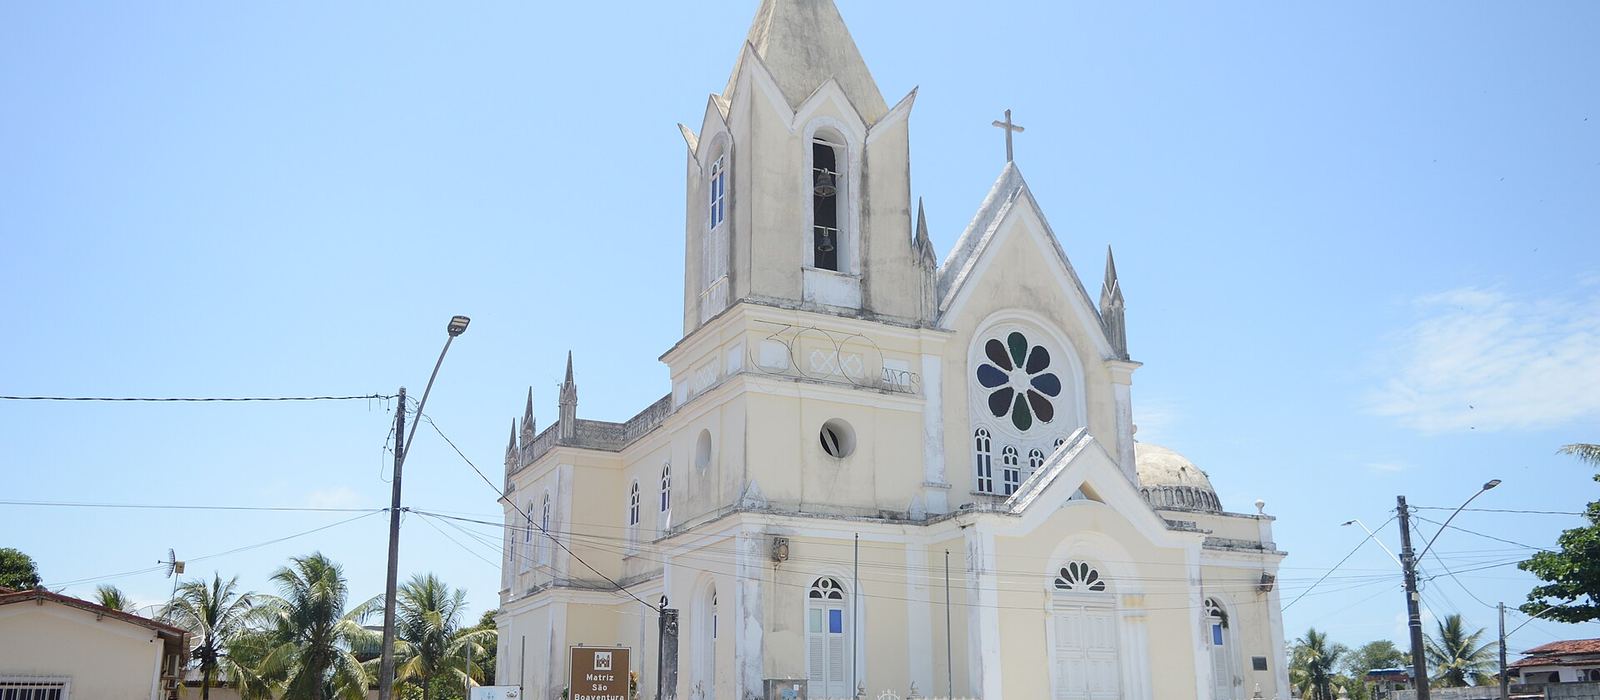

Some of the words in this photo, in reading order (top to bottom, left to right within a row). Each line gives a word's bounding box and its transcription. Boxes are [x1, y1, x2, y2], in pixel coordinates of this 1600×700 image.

[749, 319, 884, 388] 300
[881, 366, 920, 394] ANOS
[586, 673, 614, 681] Matriz
[592, 683, 608, 691] São
